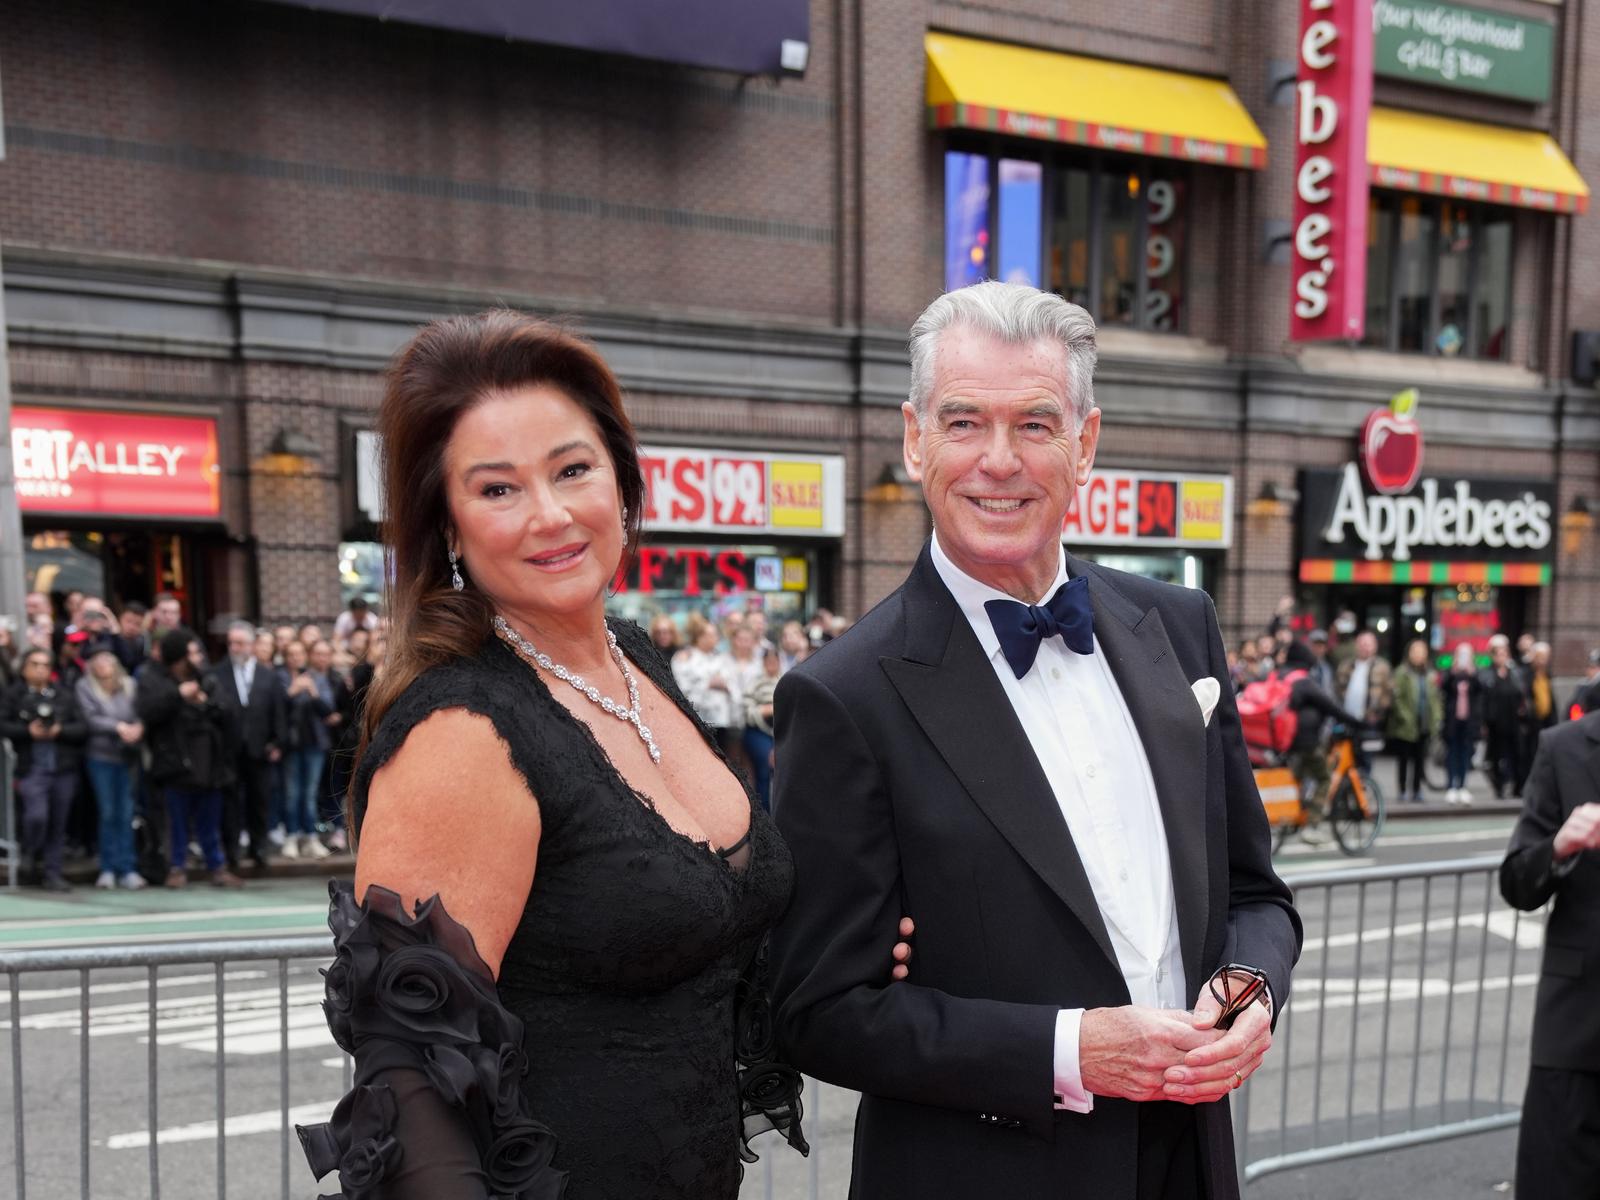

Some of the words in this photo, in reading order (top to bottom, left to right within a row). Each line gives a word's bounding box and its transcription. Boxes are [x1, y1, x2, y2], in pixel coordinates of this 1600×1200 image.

[1295, 0, 1338, 319] ebee's
[69, 439, 184, 477] ALLEY
[772, 481, 821, 508] SALE
[1062, 476, 1132, 535] AGE
[1325, 461, 1552, 561] Applebee's
